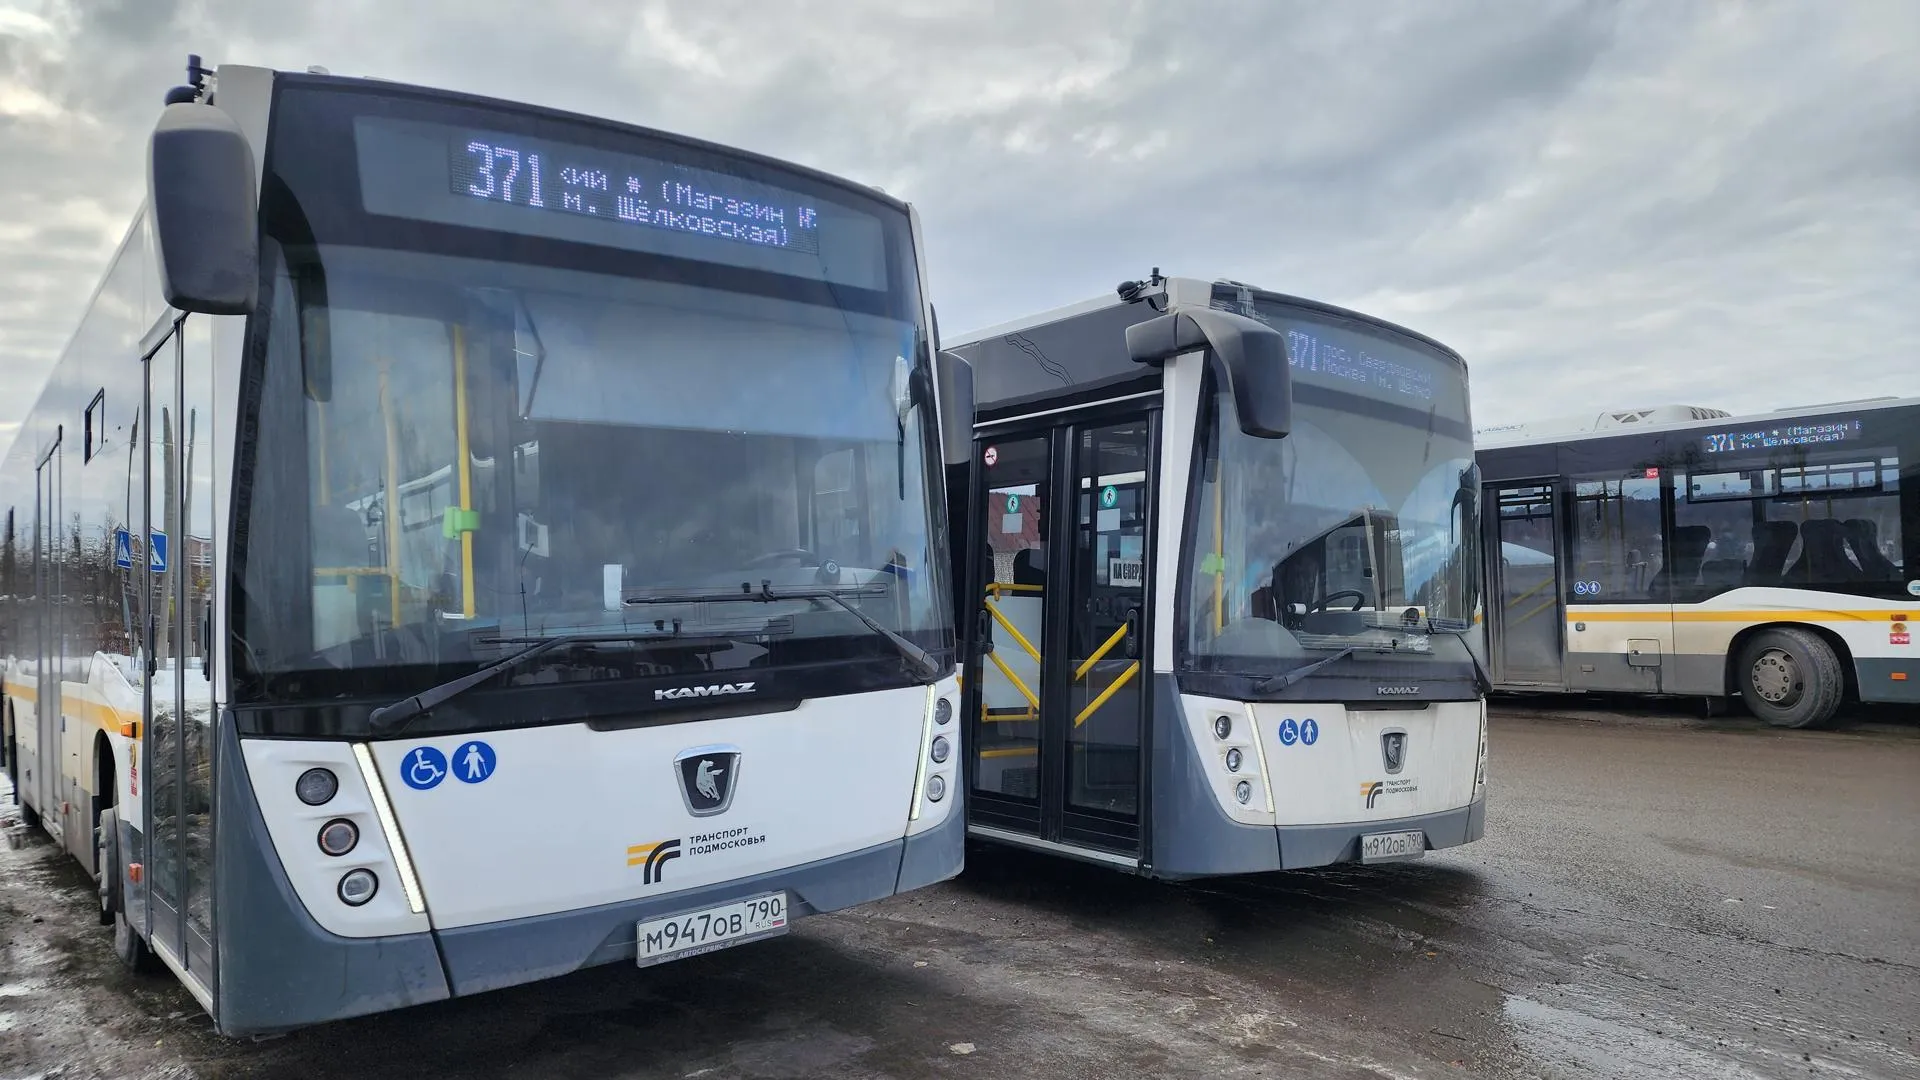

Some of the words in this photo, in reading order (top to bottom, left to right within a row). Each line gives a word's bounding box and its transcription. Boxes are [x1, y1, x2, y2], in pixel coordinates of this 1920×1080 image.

[467, 141, 543, 208] 371
[662, 179, 785, 224] (Магазин
[617, 194, 789, 247] Щёлковская)
[1288, 330, 1317, 372] 371
[1763, 431, 1846, 447] Щёлковская)
[1787, 423, 1848, 436] (Магазин
[1706, 432, 1736, 453] 371
[654, 681, 757, 701] KAMAZ
[1377, 686, 1420, 695] KAMAZ
[689, 826, 749, 845] ТРАНСПОРТ
[689, 834, 766, 856] ПОДМОСКОВЬЯ
[747, 898, 782, 923] 790
[755, 919, 772, 931] RUS
